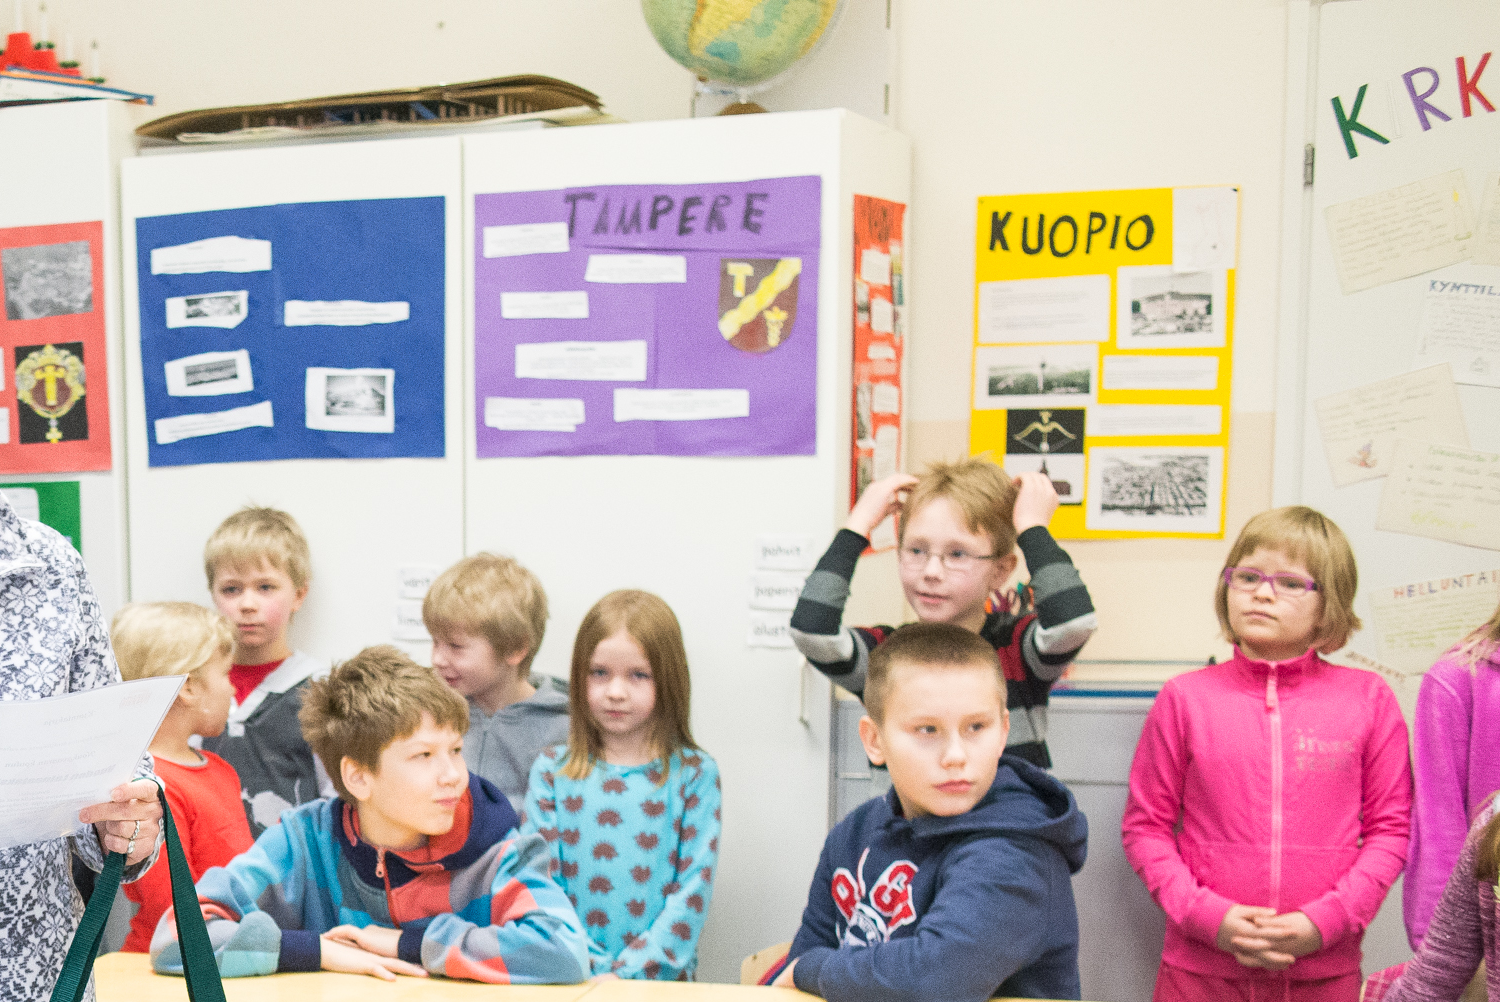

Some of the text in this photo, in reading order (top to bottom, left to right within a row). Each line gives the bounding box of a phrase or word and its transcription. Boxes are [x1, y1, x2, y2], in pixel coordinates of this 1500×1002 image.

[564, 191, 770, 238] TAMPERE
[989, 210, 1156, 258] KUOPIO
[1428, 279, 1500, 297] KYNTTIL
